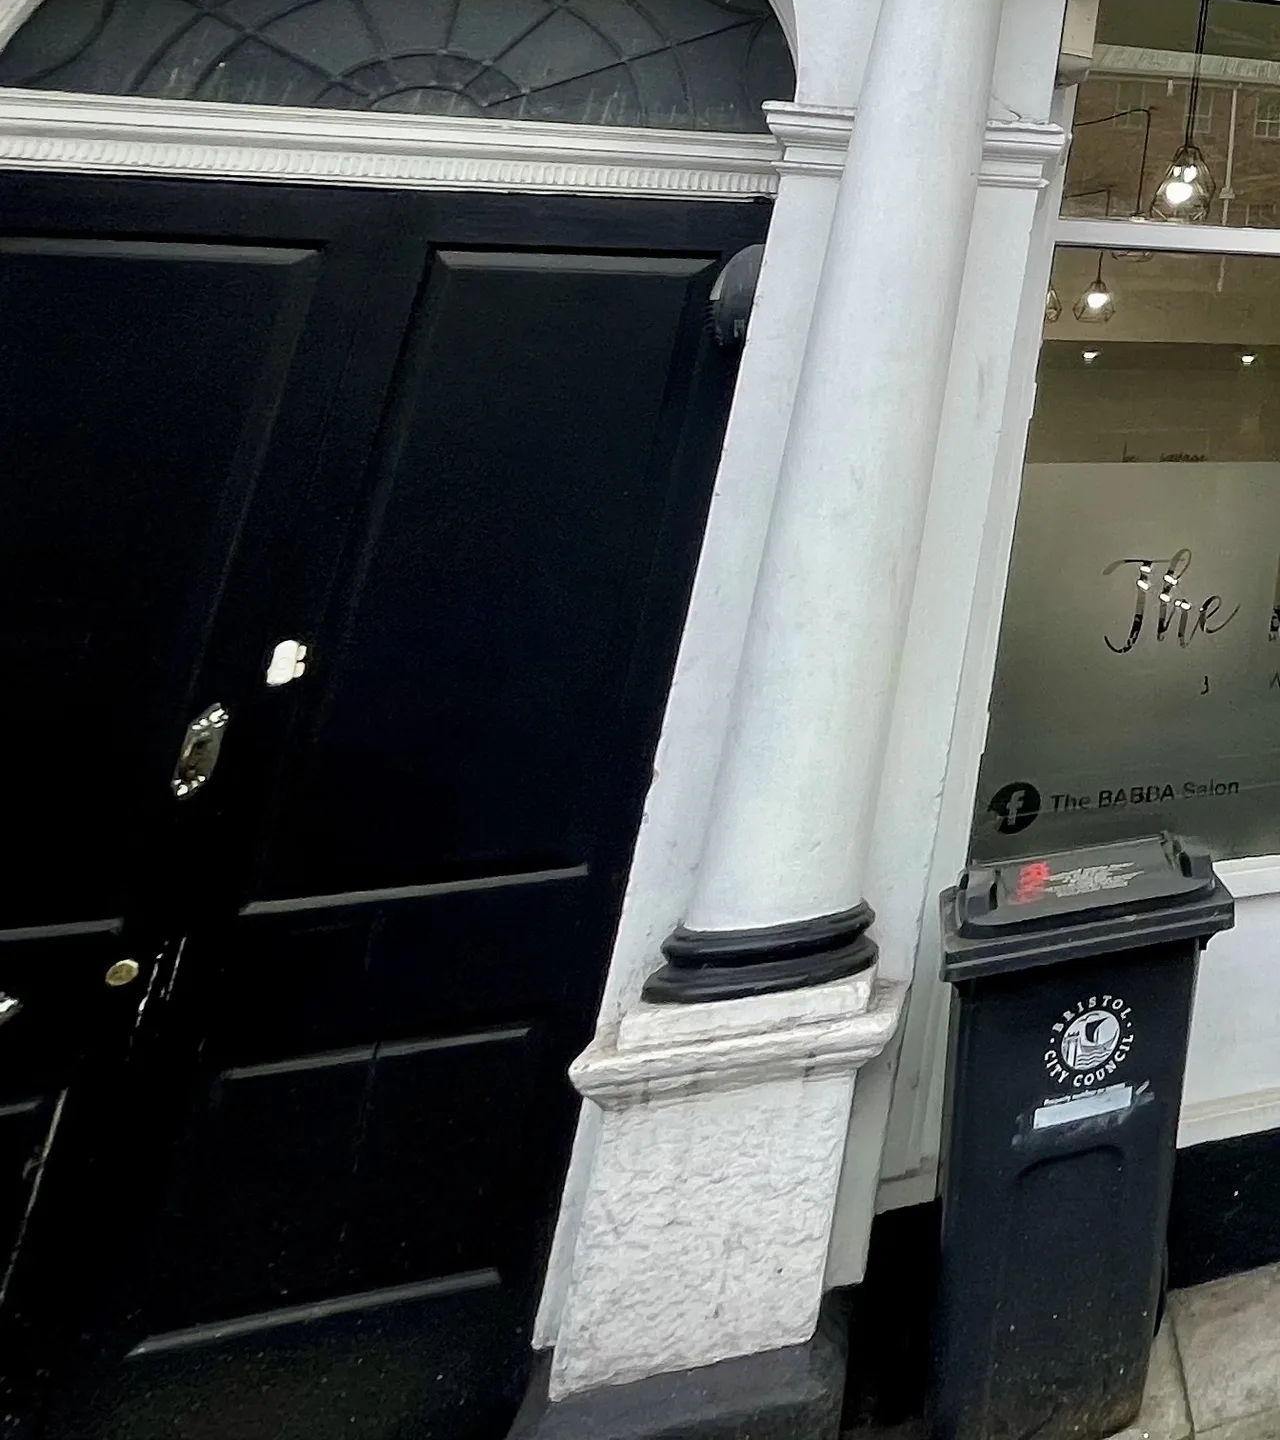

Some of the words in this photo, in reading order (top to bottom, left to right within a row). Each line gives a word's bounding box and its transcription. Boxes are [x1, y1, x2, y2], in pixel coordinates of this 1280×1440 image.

[1102, 548, 1241, 654] The
[1050, 793, 1091, 812] The
[1183, 778, 1240, 800] Salon
[1051, 994, 1133, 1033] BRISTOL
[1044, 1049, 1070, 1084] CITY
[1072, 1034, 1135, 1088] COUNCIL
